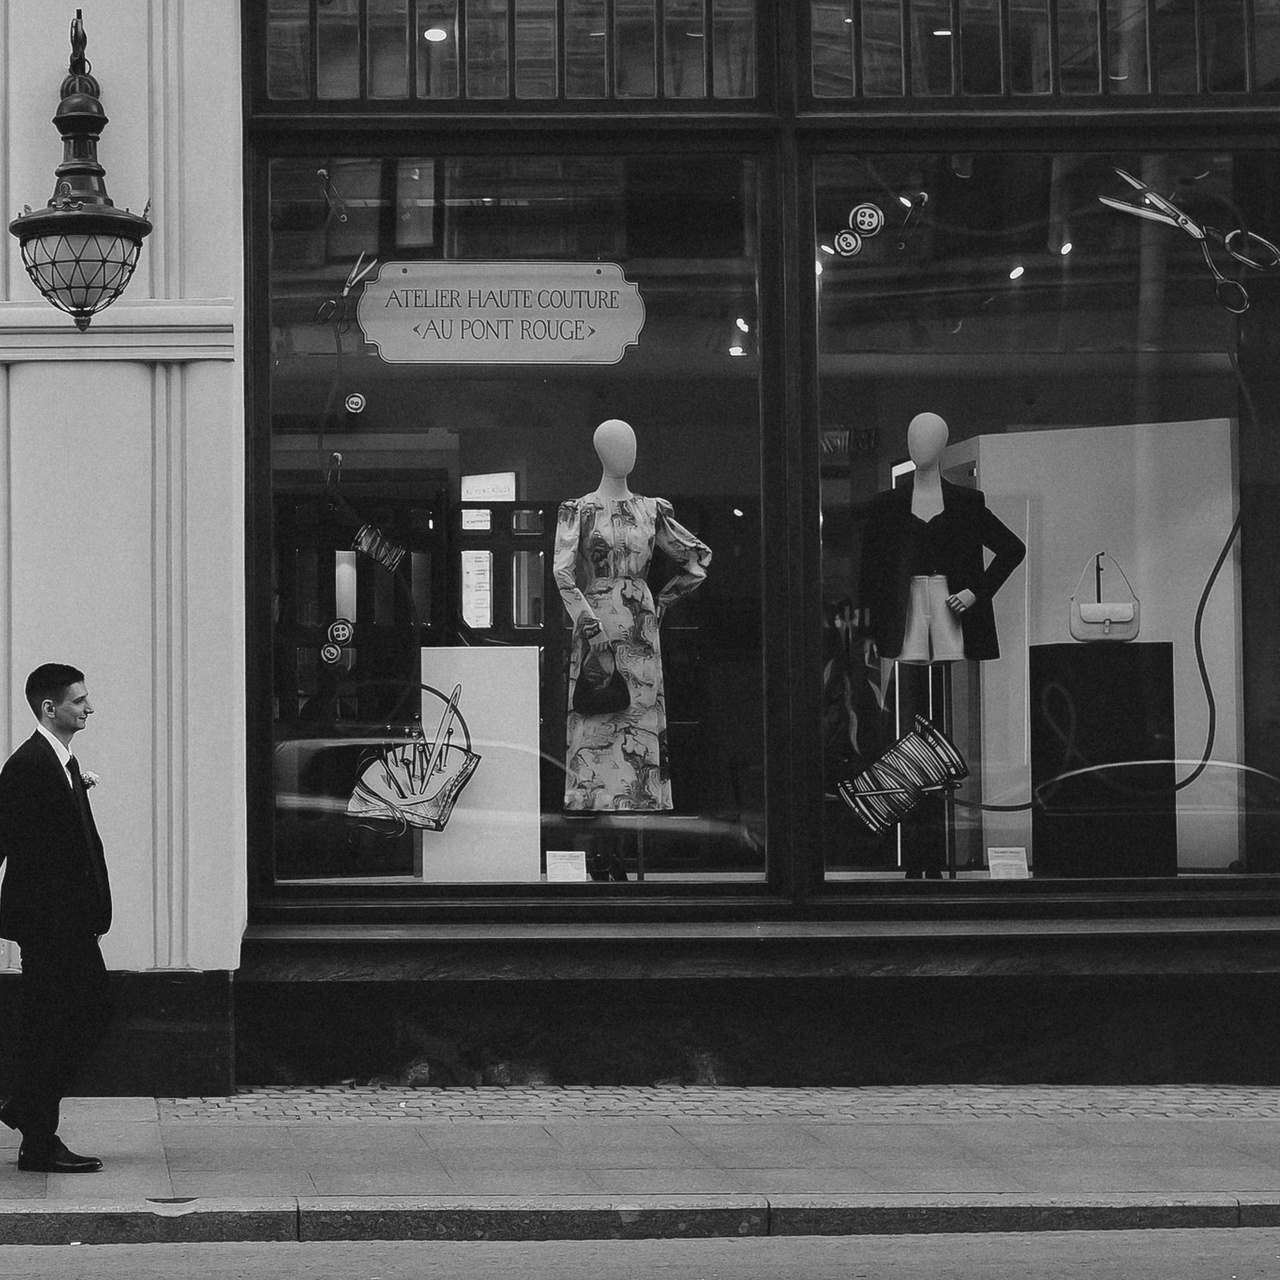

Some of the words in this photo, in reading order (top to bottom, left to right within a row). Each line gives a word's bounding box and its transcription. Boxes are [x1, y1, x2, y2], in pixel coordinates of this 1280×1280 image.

[384, 289, 462, 309] ATELIER
[468, 289, 533, 309] HAUTE
[537, 289, 620, 309] COUTURE
[460, 319, 514, 340] PONT
